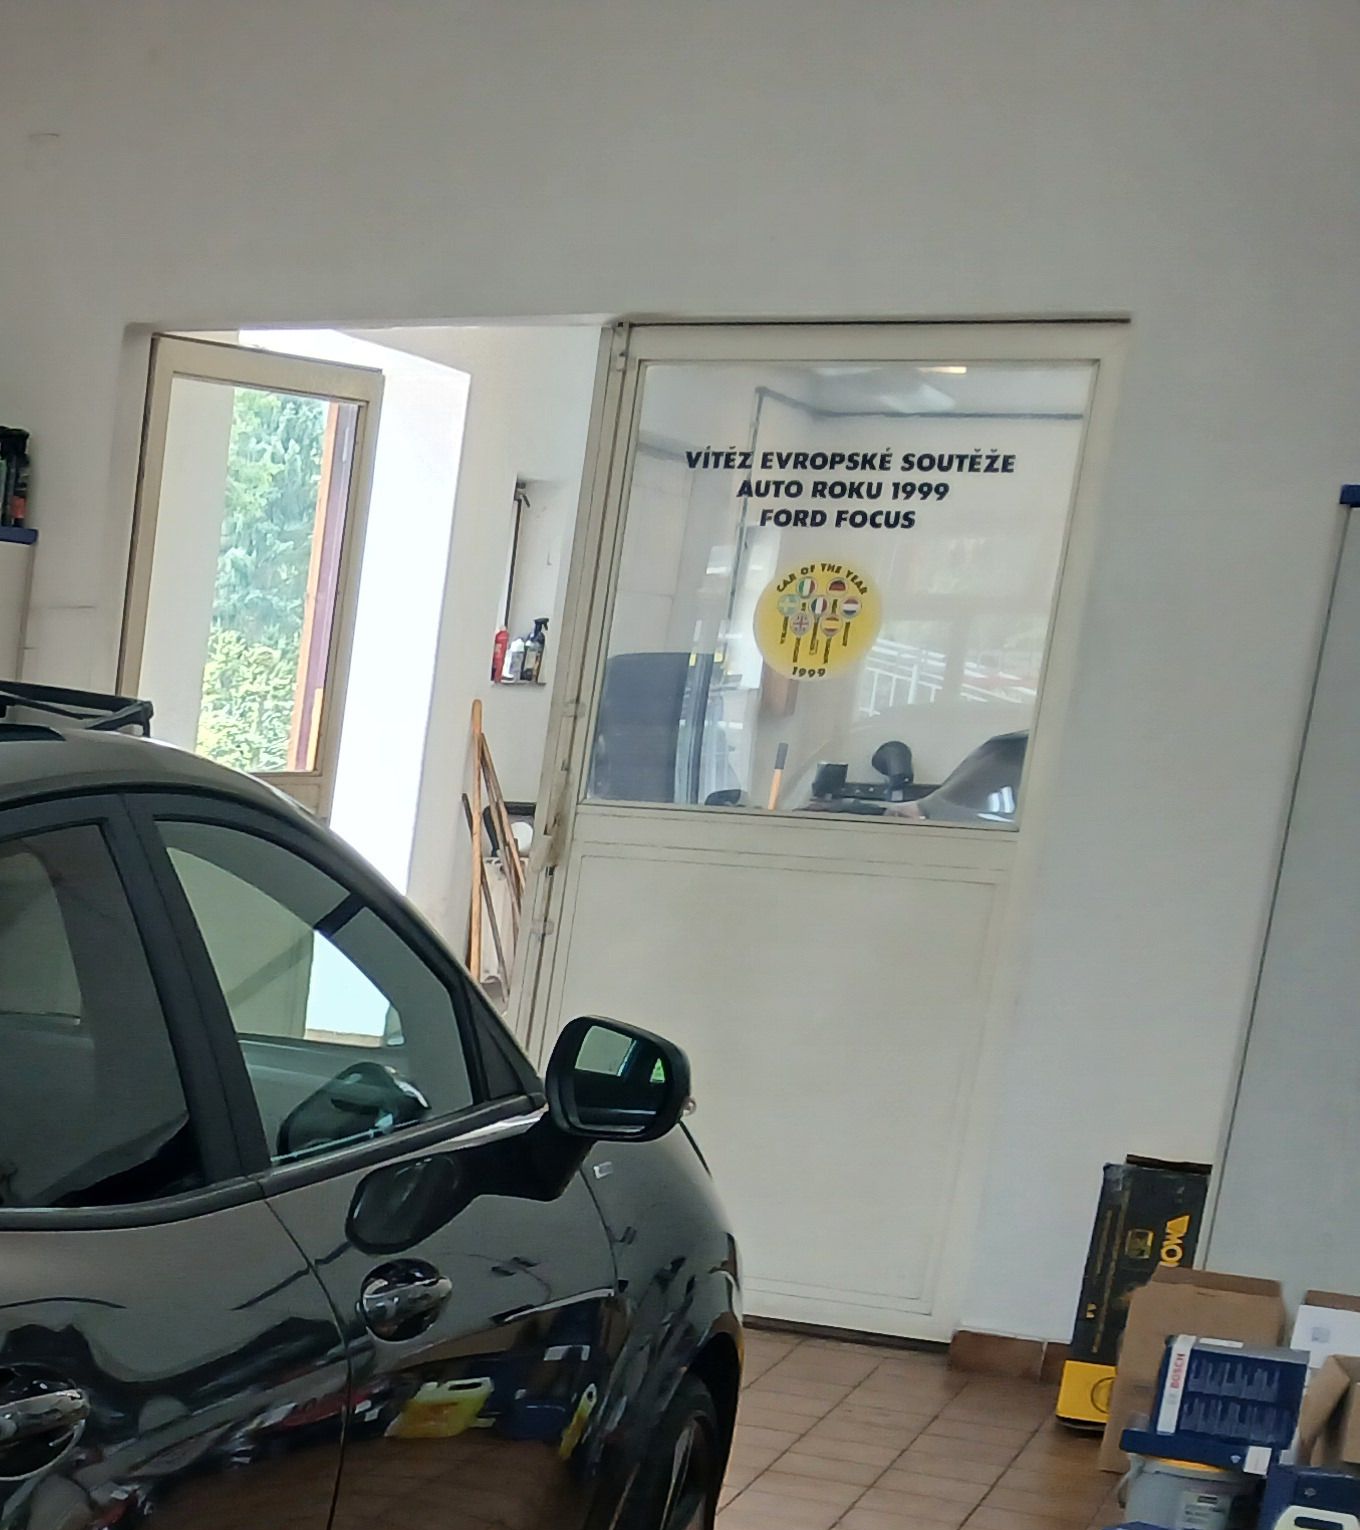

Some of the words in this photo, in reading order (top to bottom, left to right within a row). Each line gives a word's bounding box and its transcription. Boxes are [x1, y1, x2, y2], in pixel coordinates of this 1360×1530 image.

[685, 445, 753, 470] VÍTĚZ
[760, 447, 893, 472] EVROPSKÉ
[900, 448, 1017, 474] SOUTĚŽE
[736, 479, 804, 499] AUTO
[811, 480, 883, 500] ROKU
[891, 481, 950, 502] 1999
[759, 508, 828, 528] FORD
[834, 509, 916, 530] FOCUS
[776, 573, 797, 593] CAR
[800, 564, 816, 576] OF
[820, 562, 842, 574] THE
[844, 569, 868, 596] YEAR
[792, 665, 826, 678] 1999
[1169, 1352, 1186, 1389] BOSCH
